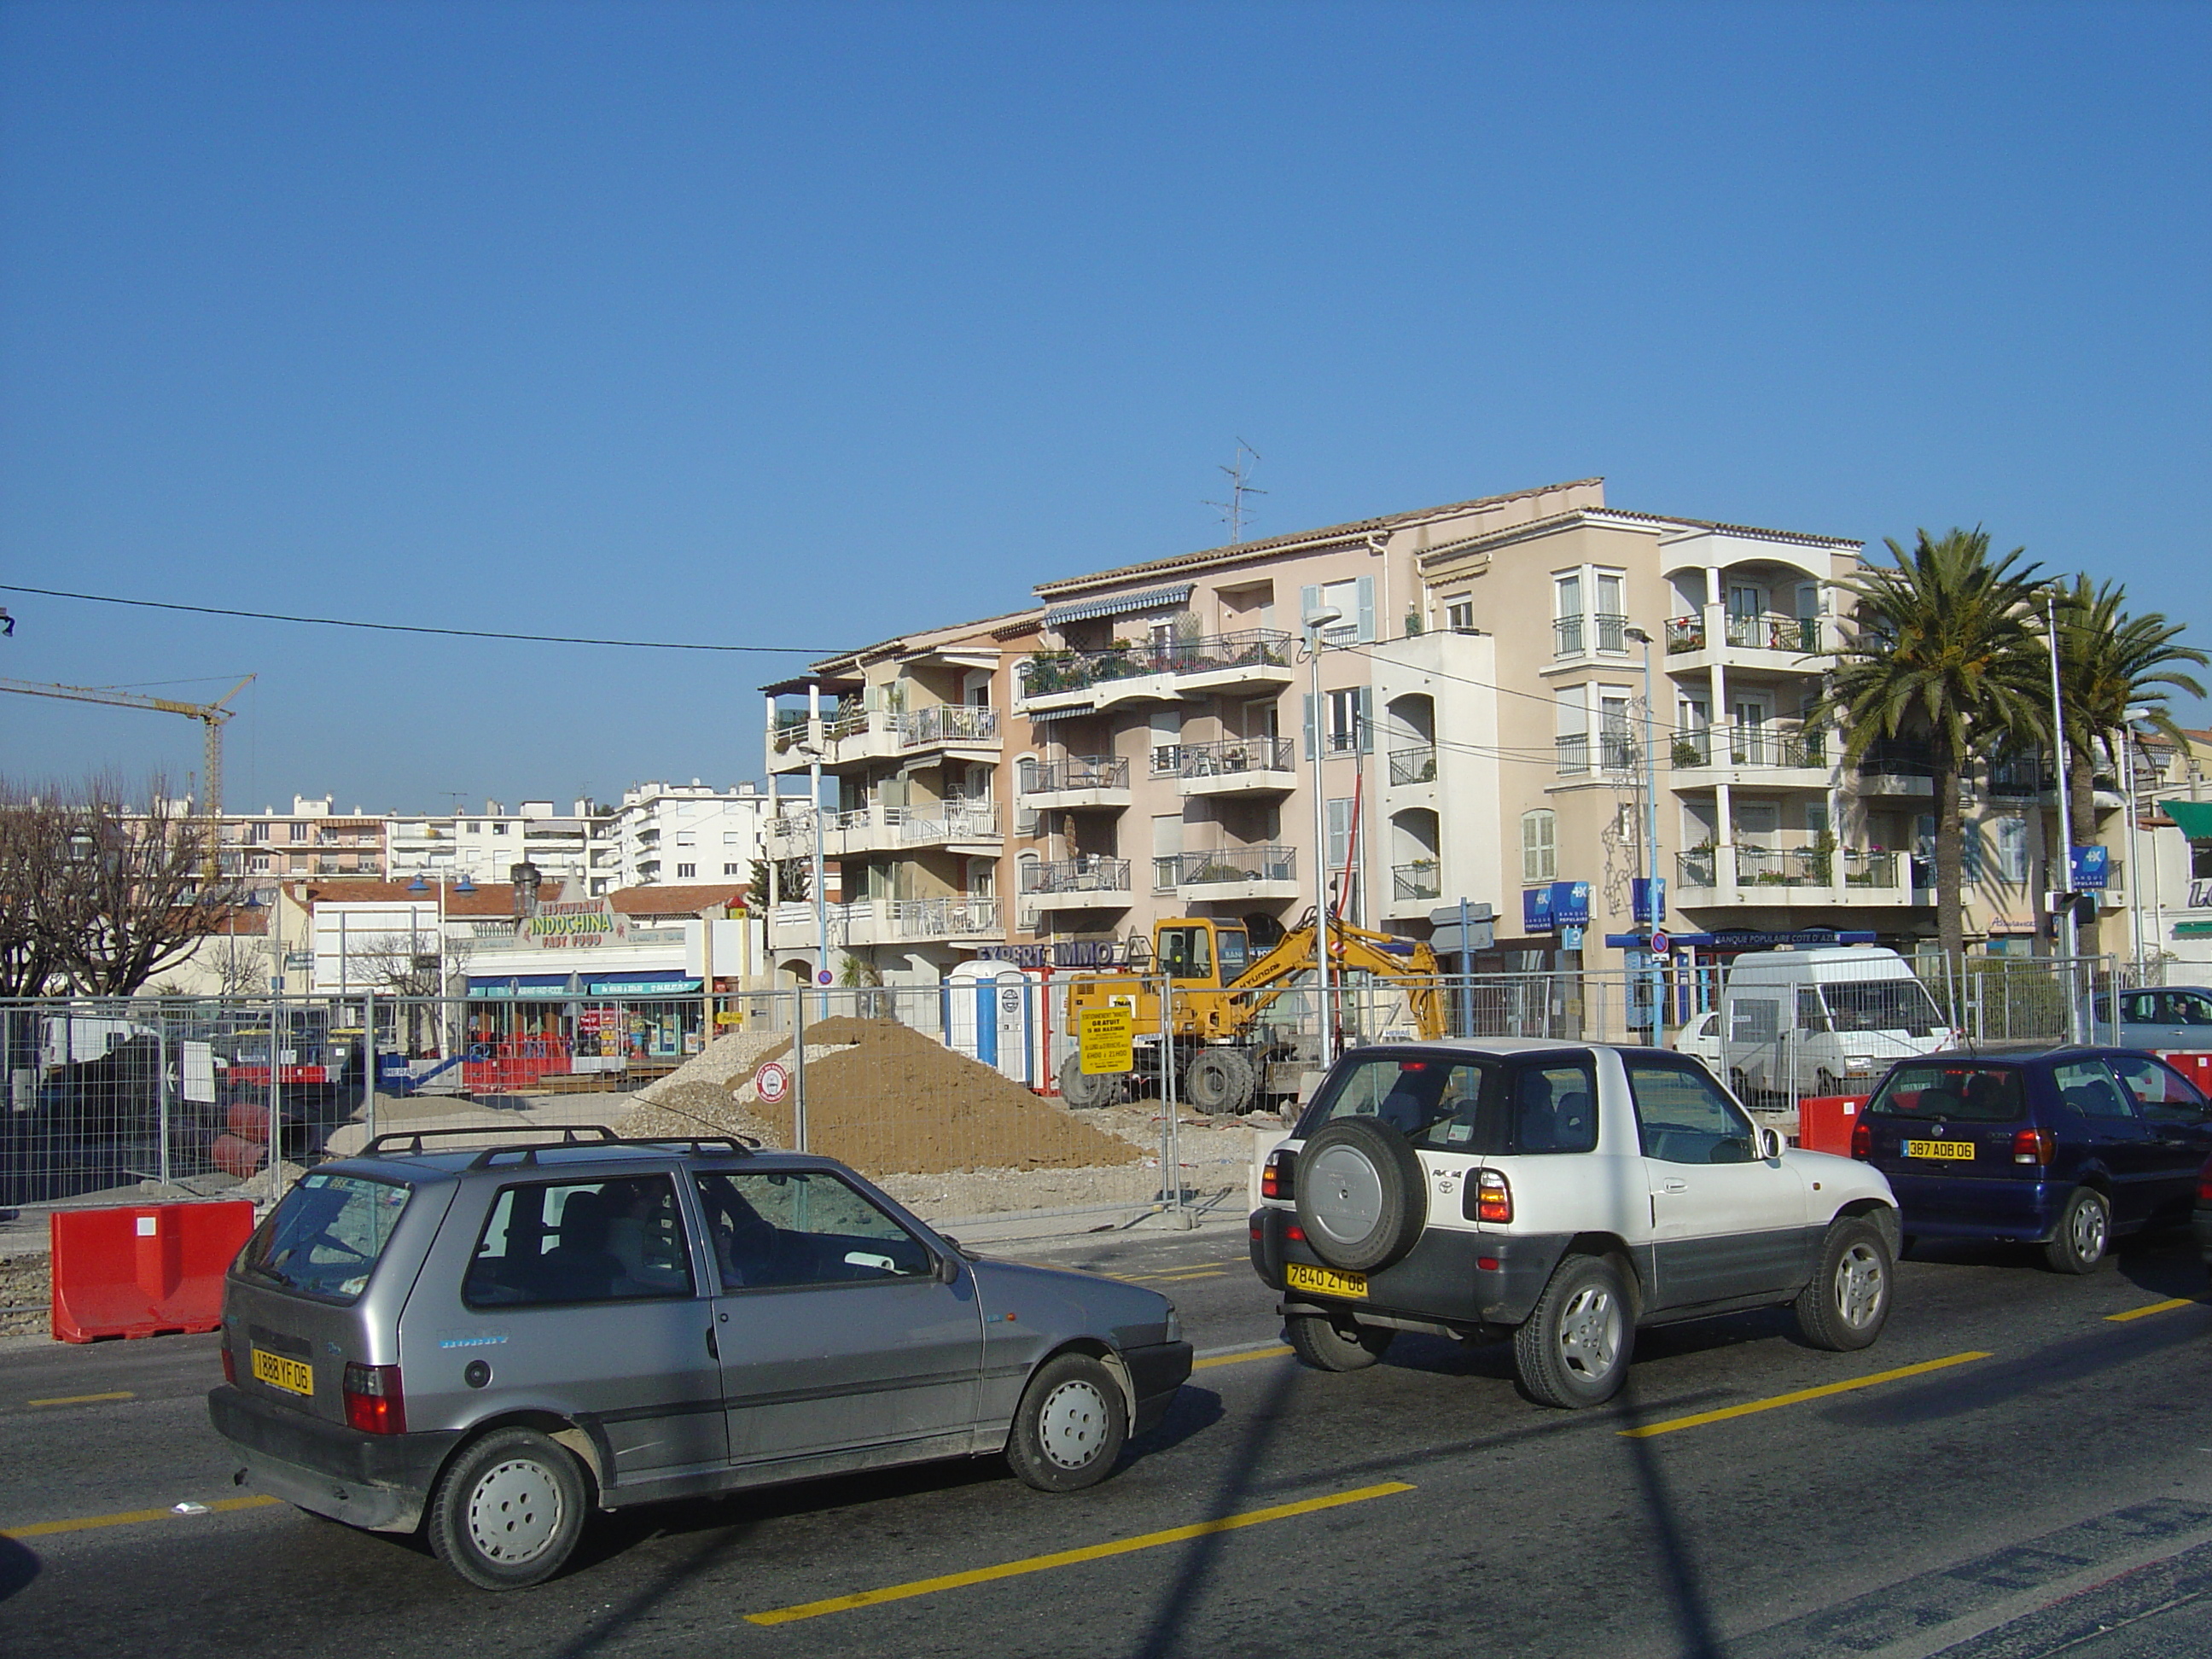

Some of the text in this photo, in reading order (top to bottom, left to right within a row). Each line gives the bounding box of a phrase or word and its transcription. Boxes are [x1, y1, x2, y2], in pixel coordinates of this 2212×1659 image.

[531, 914, 614, 935] INDOCHINA
[543, 934, 602, 948] FAST FOOD
[1715, 935, 1748, 945] BANQUE
[1749, 934, 1789, 943] POPULAIRE
[1821, 934, 1841, 942] AZUR
[977, 940, 1114, 967] EXPERT IMMO
[1239, 963, 1281, 988] HYUNDAI
[386, 1068, 417, 1077] HERAS
[1910, 1143, 1972, 1157] 387 ADB 06
[1291, 1266, 1324, 1286] 7840
[1328, 1272, 1344, 1289] ZY
[1348, 1275, 1364, 1292] 06
[258, 1353, 279, 1380] 1888
[280, 1359, 292, 1384] YF
[294, 1364, 307, 1389] 06
